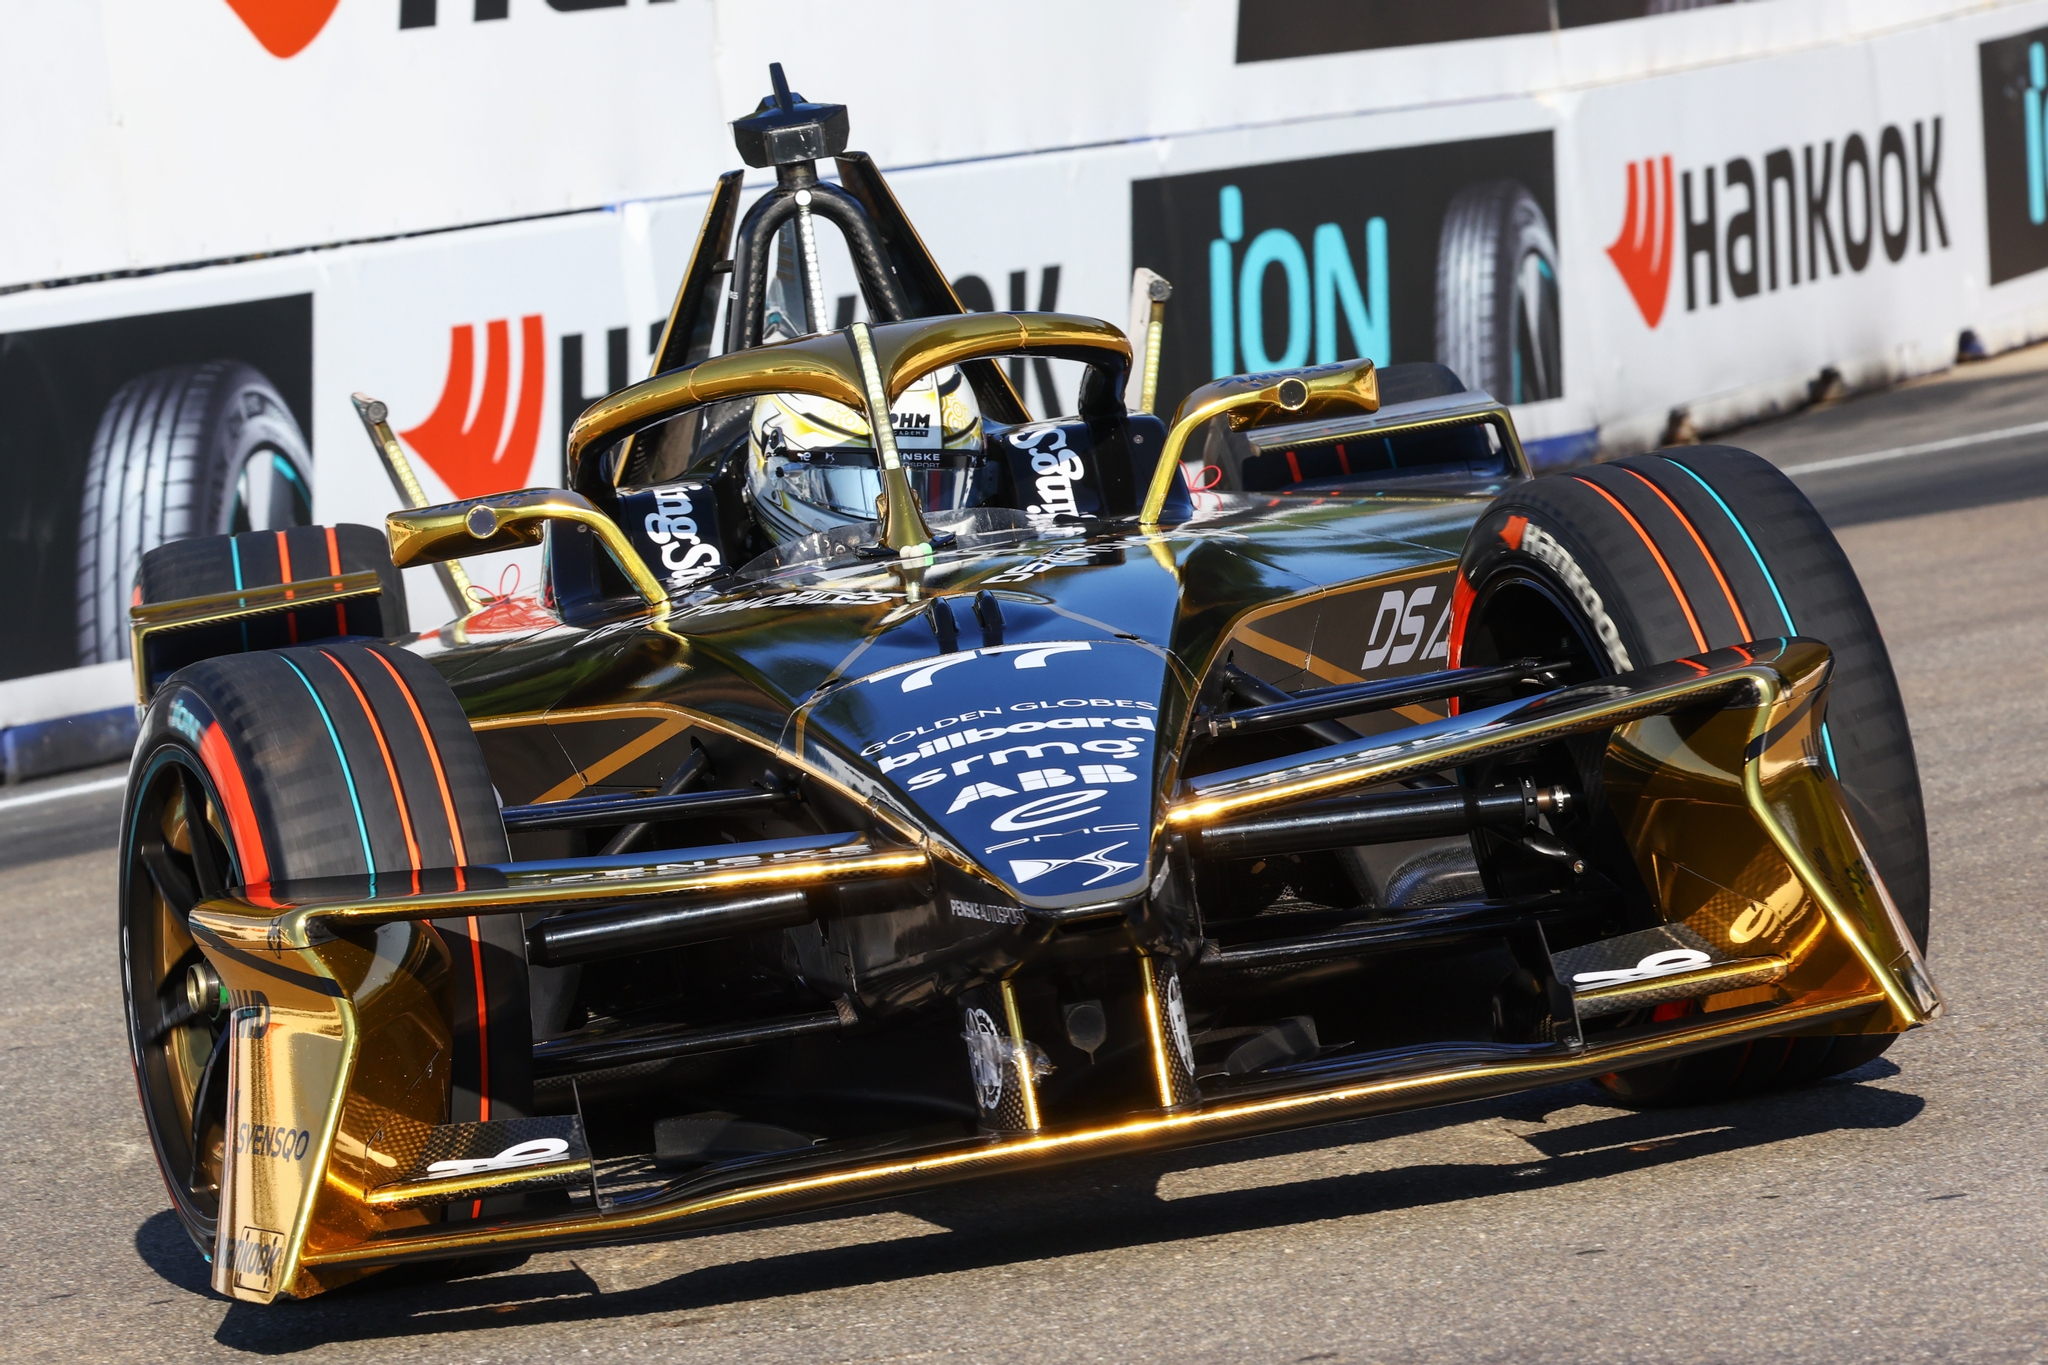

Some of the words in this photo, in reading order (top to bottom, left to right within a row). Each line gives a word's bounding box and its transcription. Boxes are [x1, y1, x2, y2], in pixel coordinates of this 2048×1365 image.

[860, 706, 1003, 757] GOLDEN
[1010, 698, 1158, 712] GLOBES
[877, 716, 1157, 774] billboard
[946, 764, 1138, 814] ABB
[950, 899, 981, 920] PENSKE
[980, 904, 1030, 925] AUTOSPORT
[237, 1122, 310, 1162] SYENSQO
